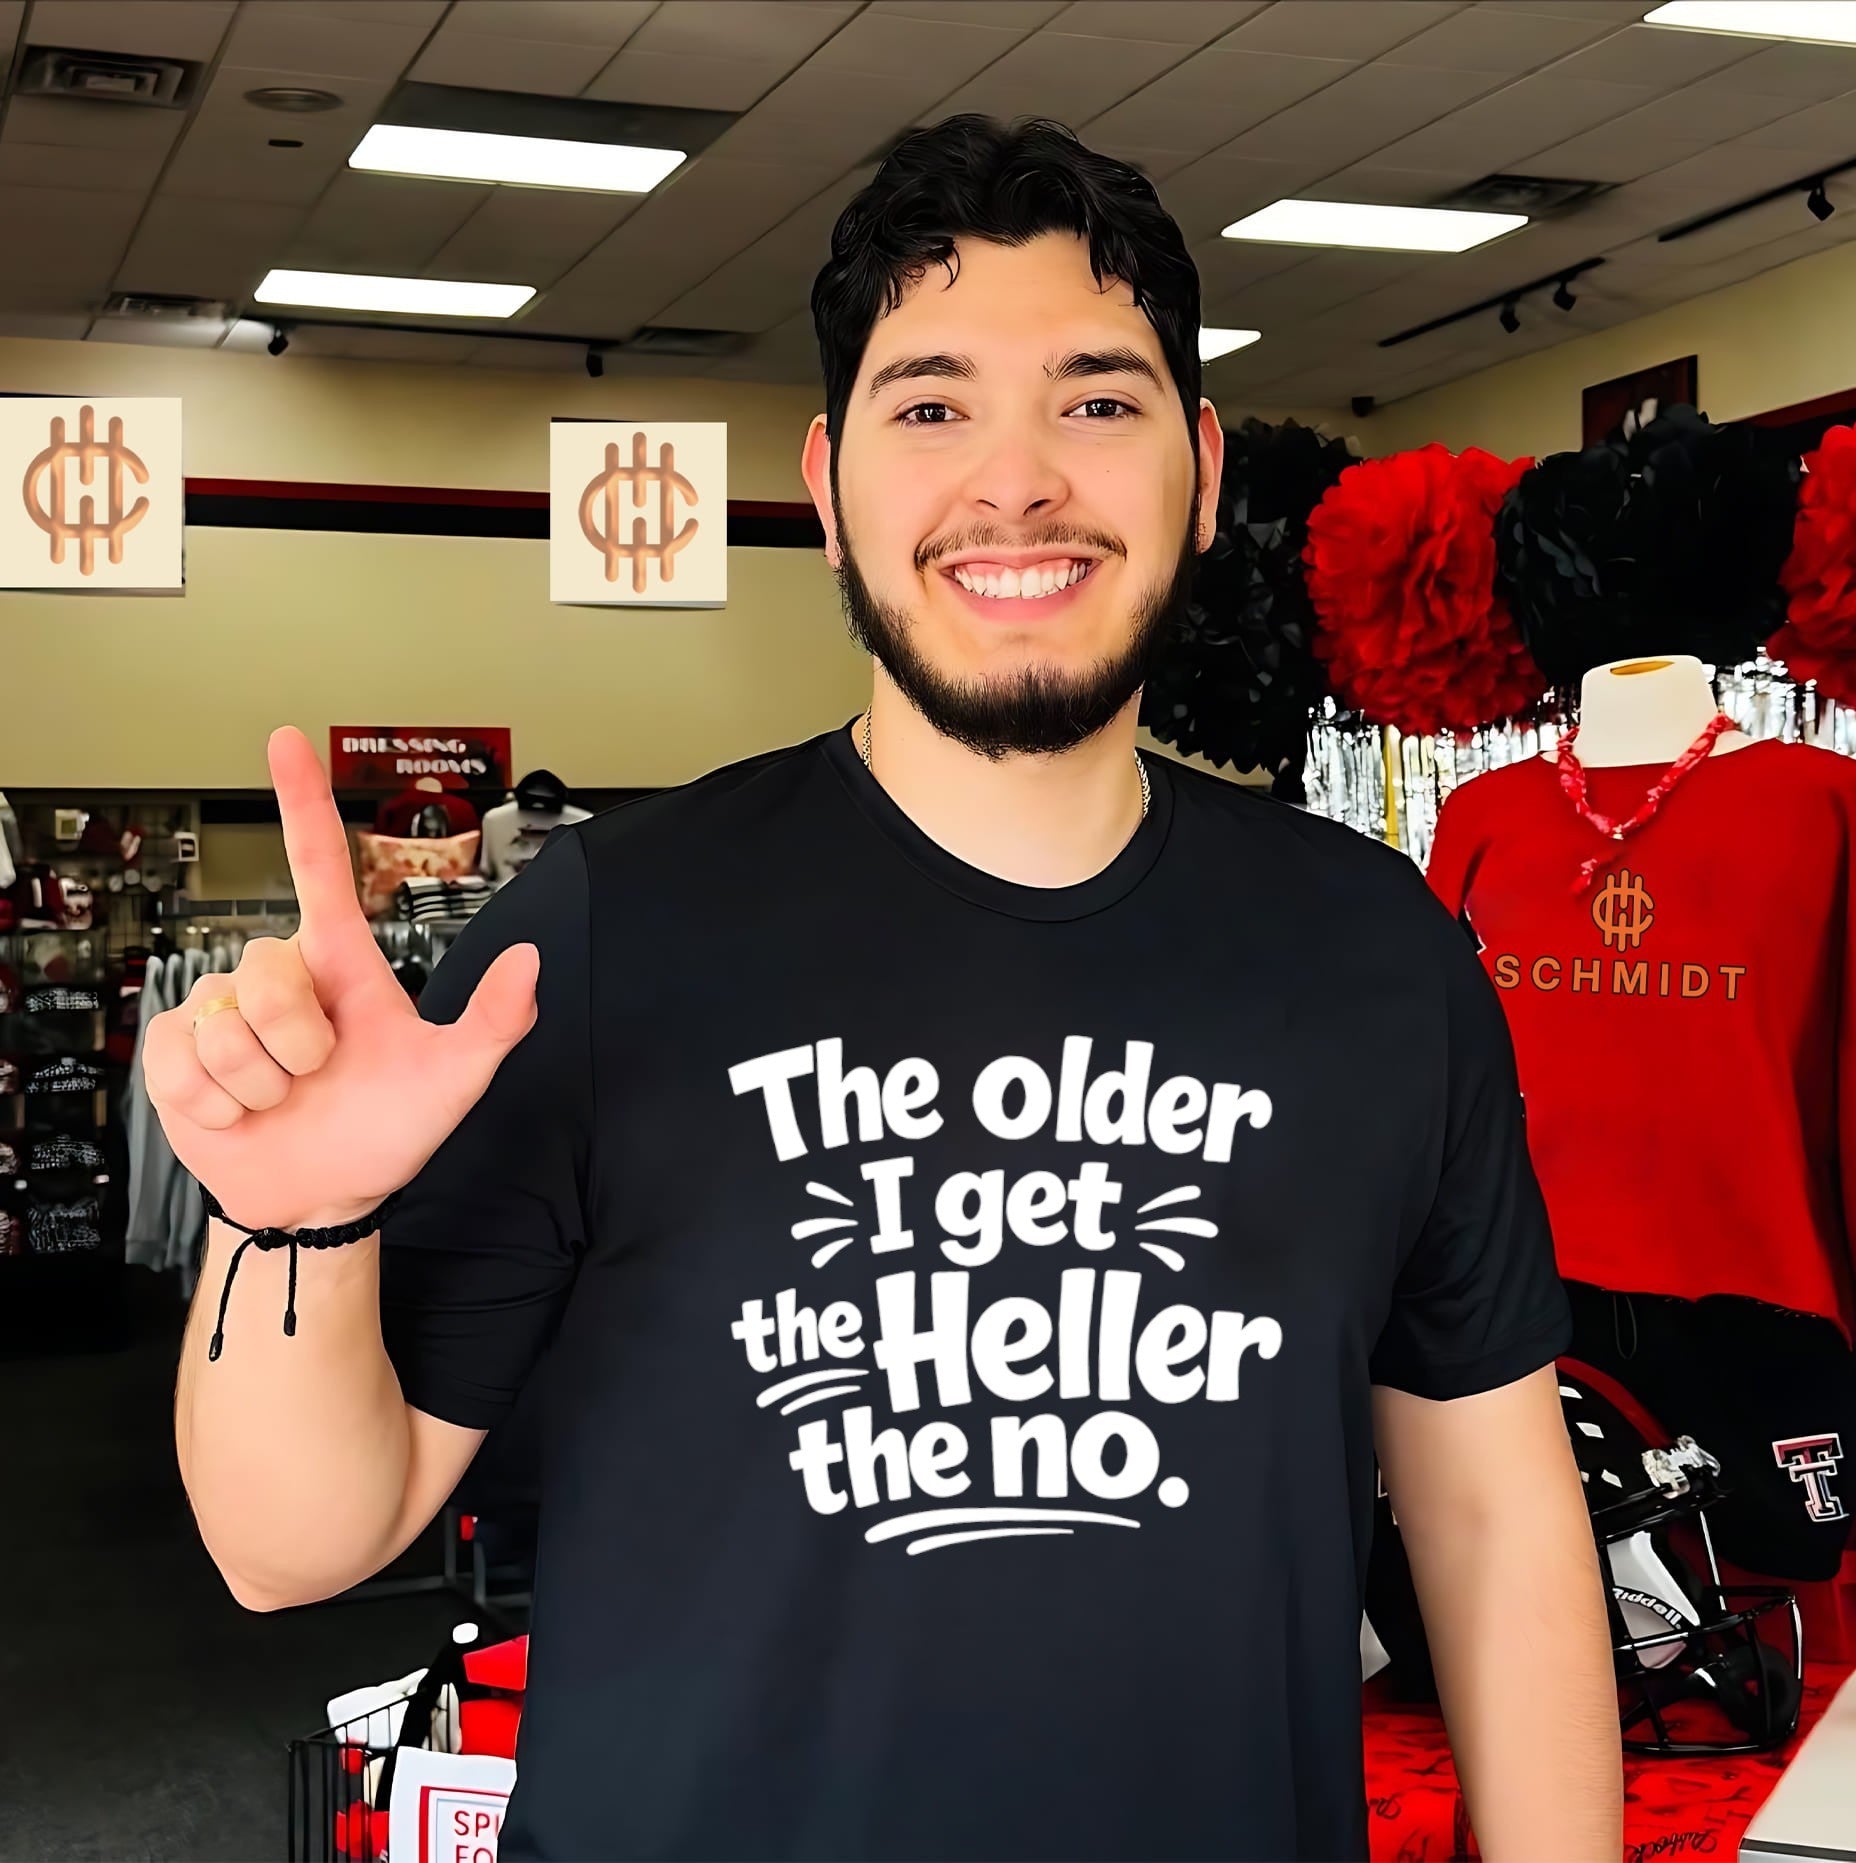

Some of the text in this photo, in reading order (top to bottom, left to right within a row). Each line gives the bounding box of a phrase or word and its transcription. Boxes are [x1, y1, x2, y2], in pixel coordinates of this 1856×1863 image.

[396, 758, 487, 775] ROOMS
[1493, 954, 1748, 1000] SCHMIDT
[728, 1034, 1273, 1163] The older
[860, 1156, 1123, 1268] I get
[730, 1267, 1283, 1414] the Heller
[788, 1405, 1190, 1515] the no.
